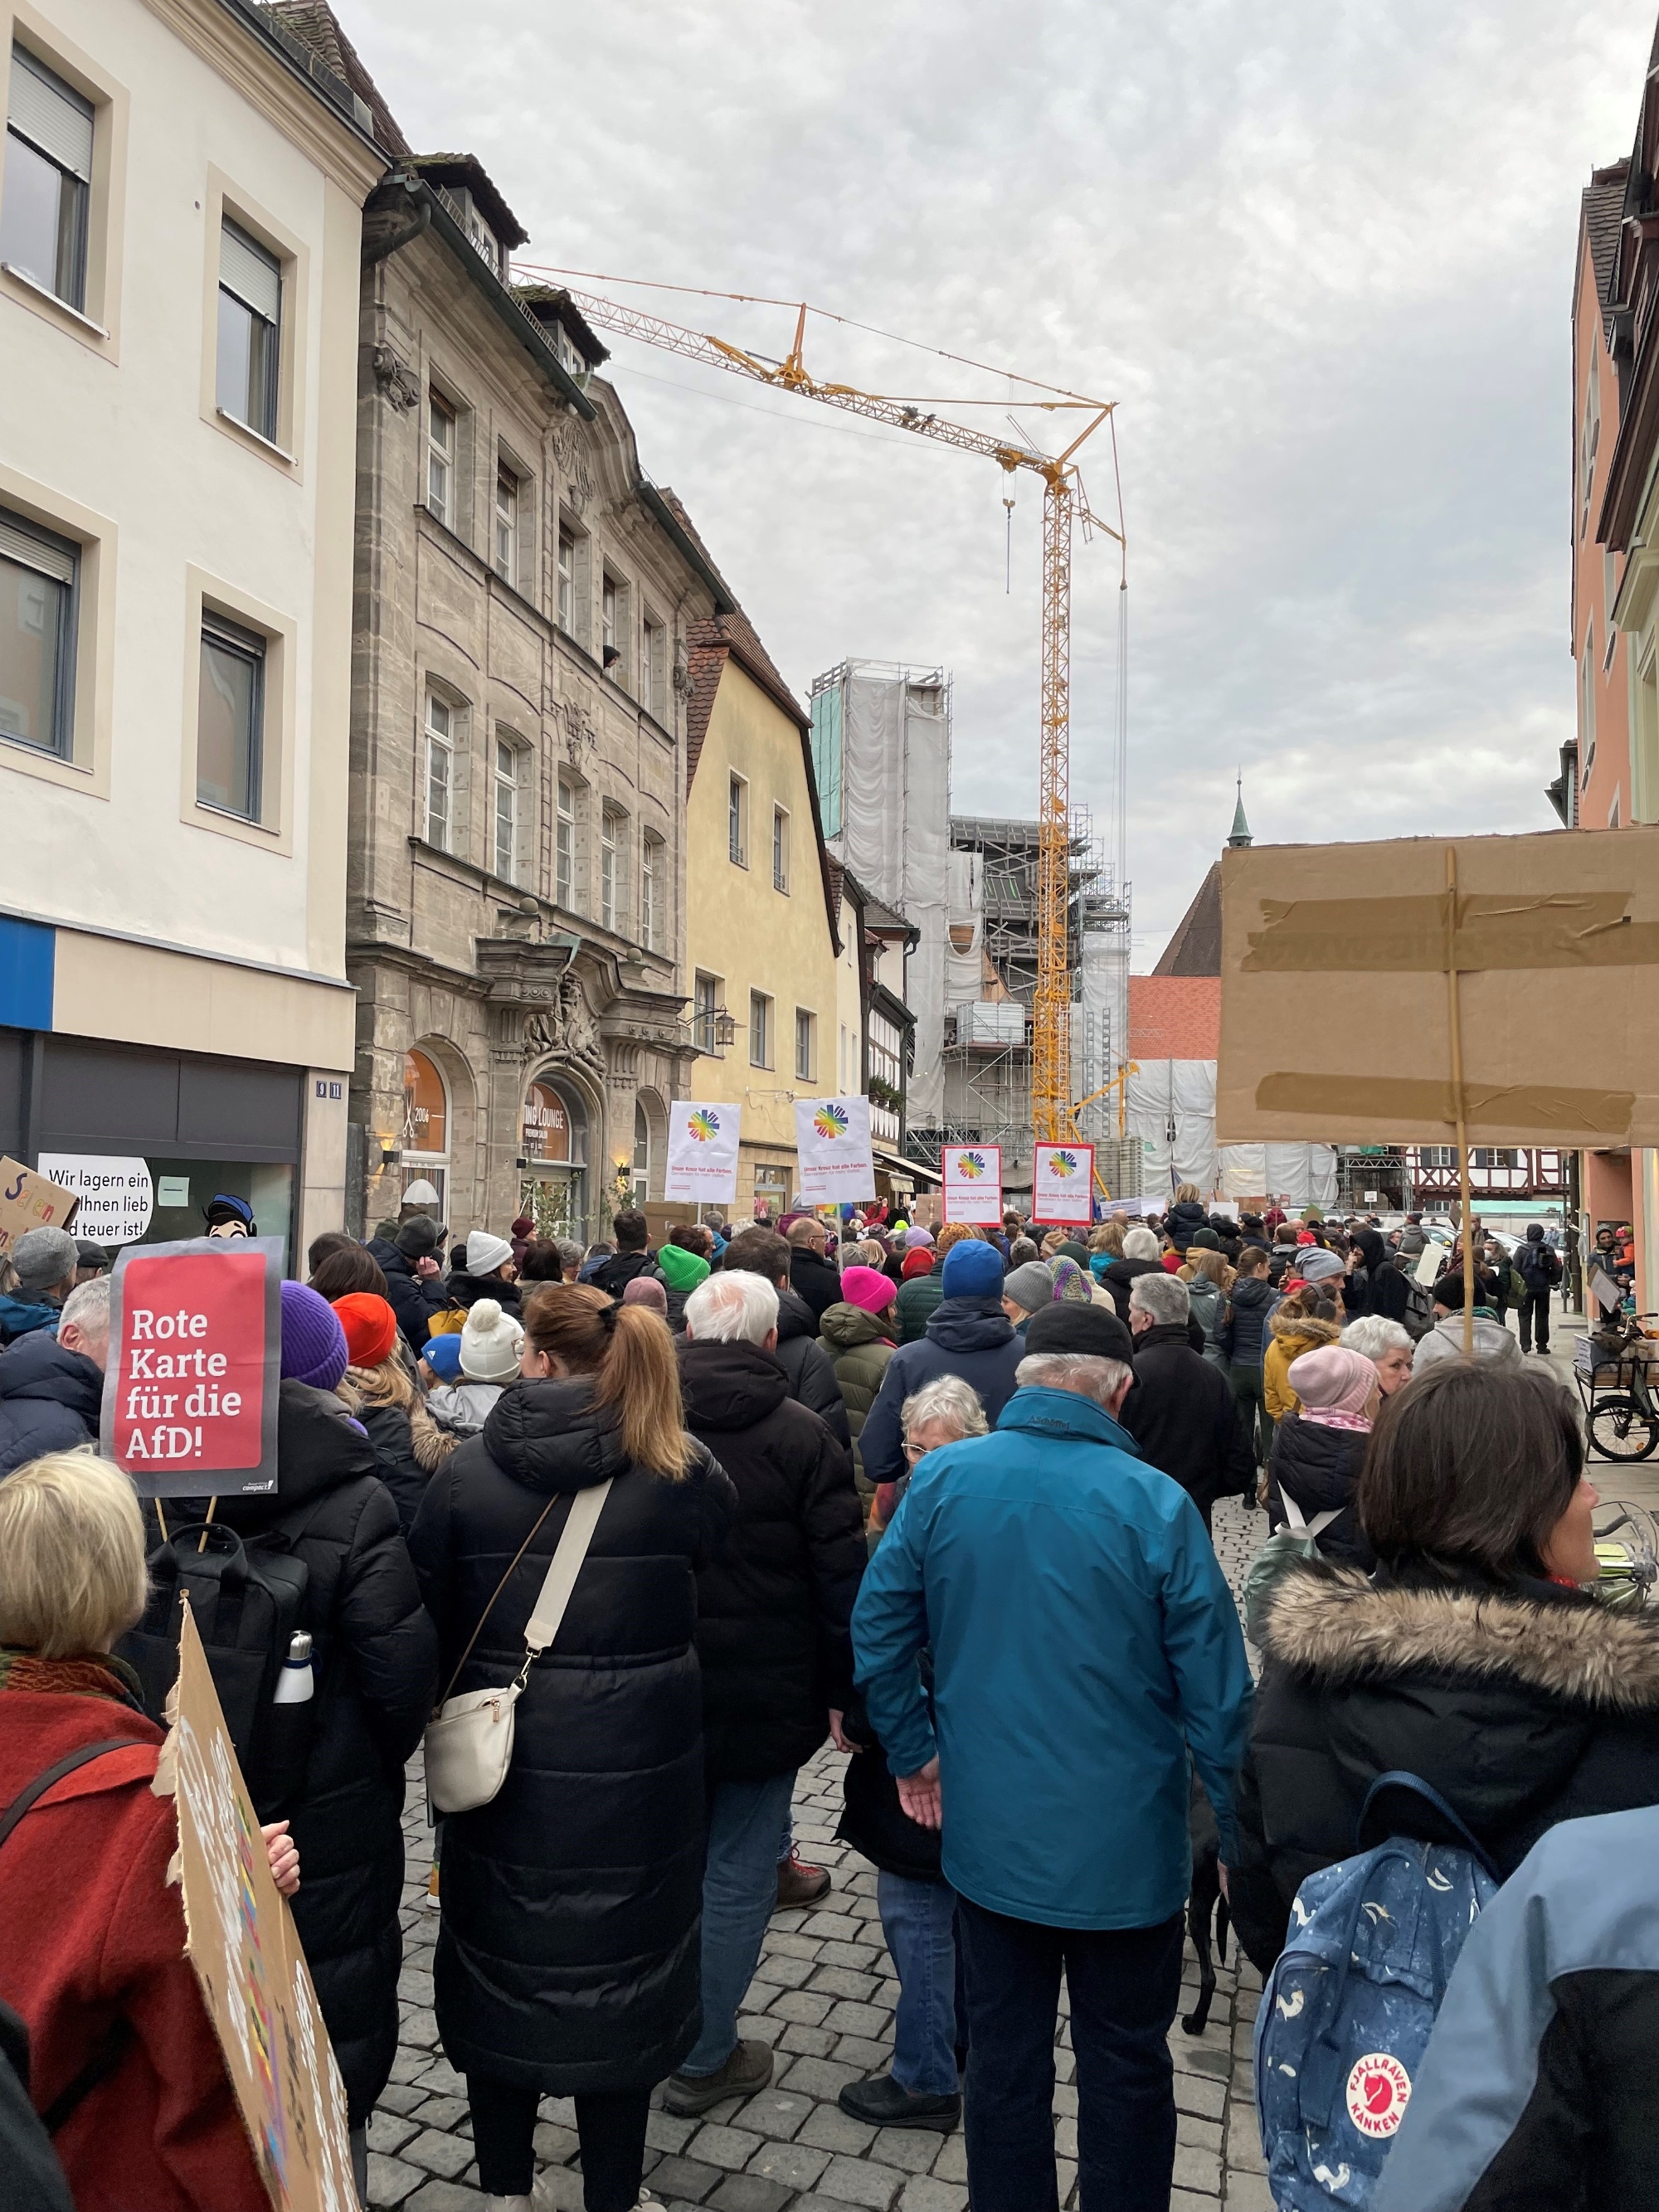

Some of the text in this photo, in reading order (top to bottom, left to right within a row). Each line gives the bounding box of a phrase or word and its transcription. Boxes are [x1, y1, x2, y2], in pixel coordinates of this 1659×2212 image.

[415, 1107, 430, 1122] 2006
[538, 1107, 564, 1129] LOUNGE
[49, 1169, 148, 1191] Wir lagern ein
[80, 1195, 148, 1212] Ihnen lieb
[82, 1223, 120, 1236] teuer
[124, 1221, 143, 1236] ist!
[131, 1310, 207, 1340] Rote
[129, 1349, 227, 1379] Karte
[125, 1383, 241, 1419] für die
[125, 1426, 202, 1459] AfD!
